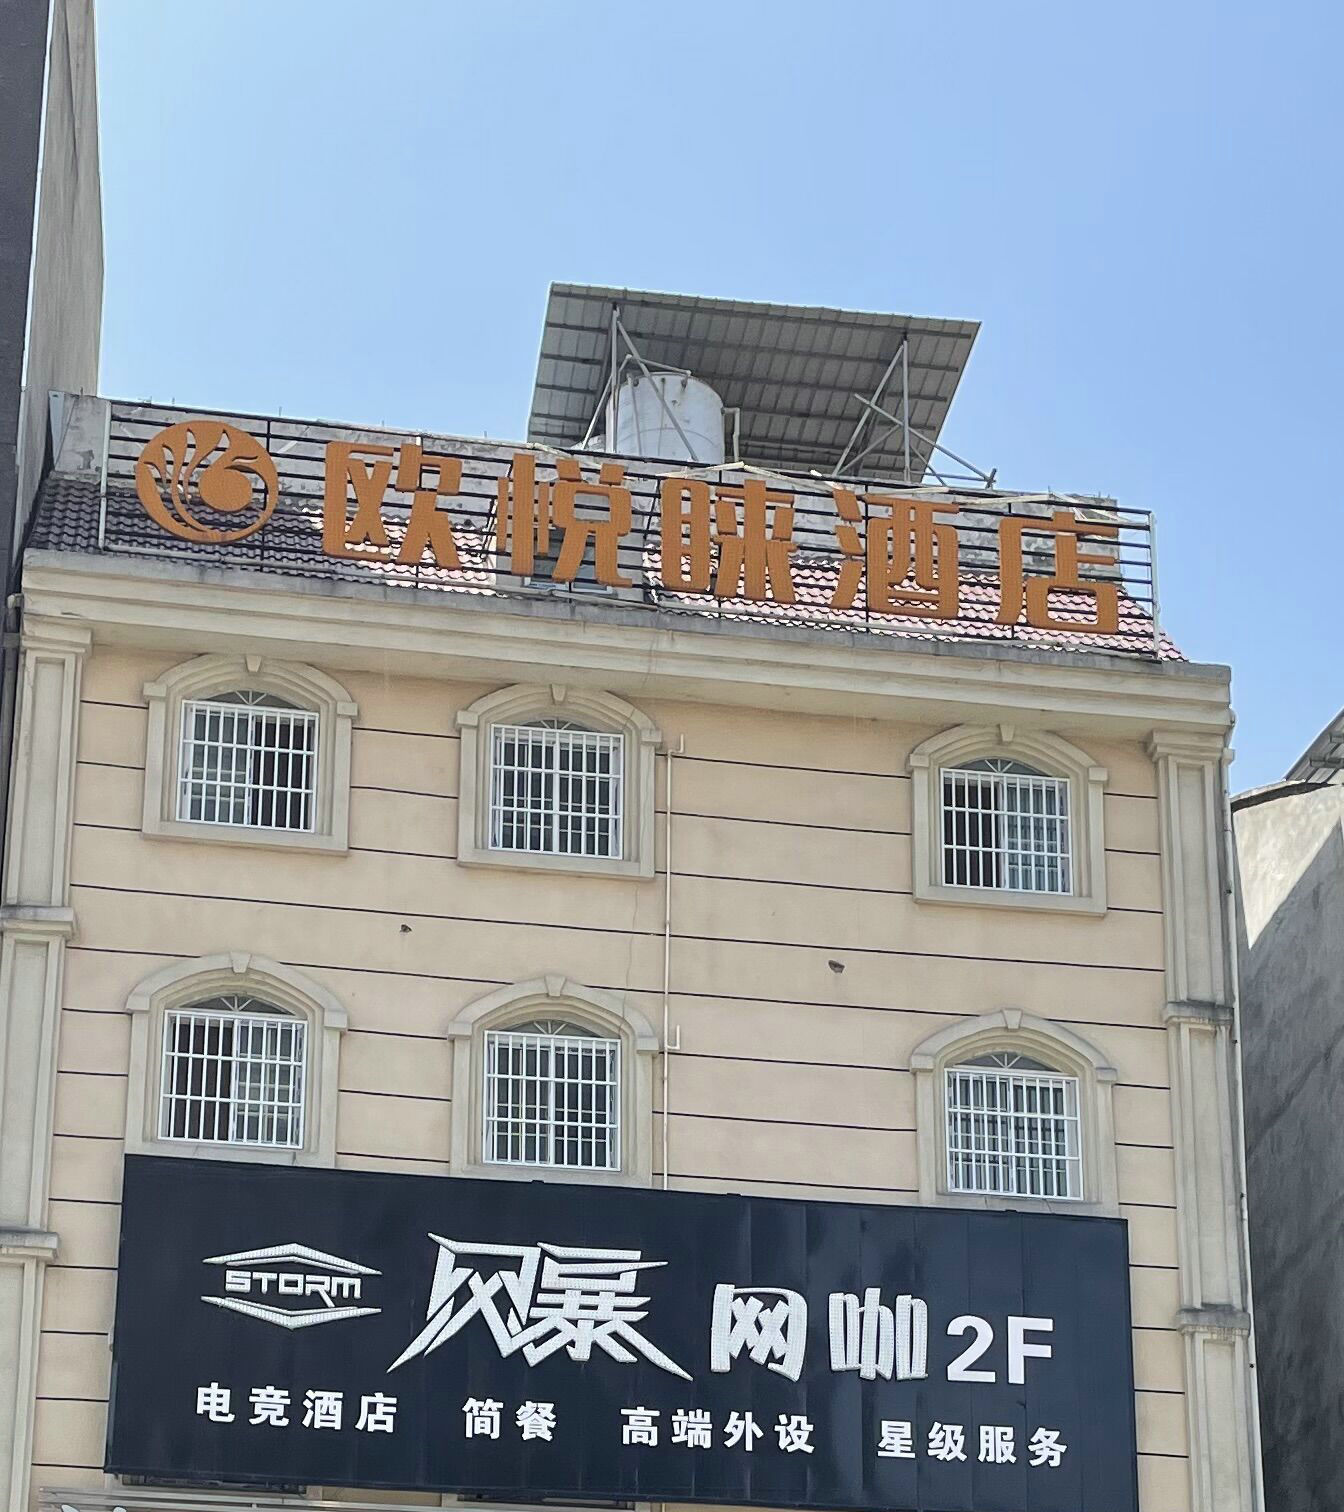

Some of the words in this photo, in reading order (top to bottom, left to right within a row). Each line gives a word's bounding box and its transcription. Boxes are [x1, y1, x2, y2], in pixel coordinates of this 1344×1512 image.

[323, 441, 1122, 634] 欧悦睐酒店
[223, 1271, 364, 1308] STORM
[387, 1232, 693, 1380] 风暴
[710, 1283, 929, 1382] 网咖
[946, 1315, 1054, 1386] 2F
[196, 1382, 398, 1433] 电竞酒店
[463, 1397, 559, 1441] 简餐
[621, 1406, 816, 1453] 高端外设
[878, 1421, 1069, 1467] 星级服务
